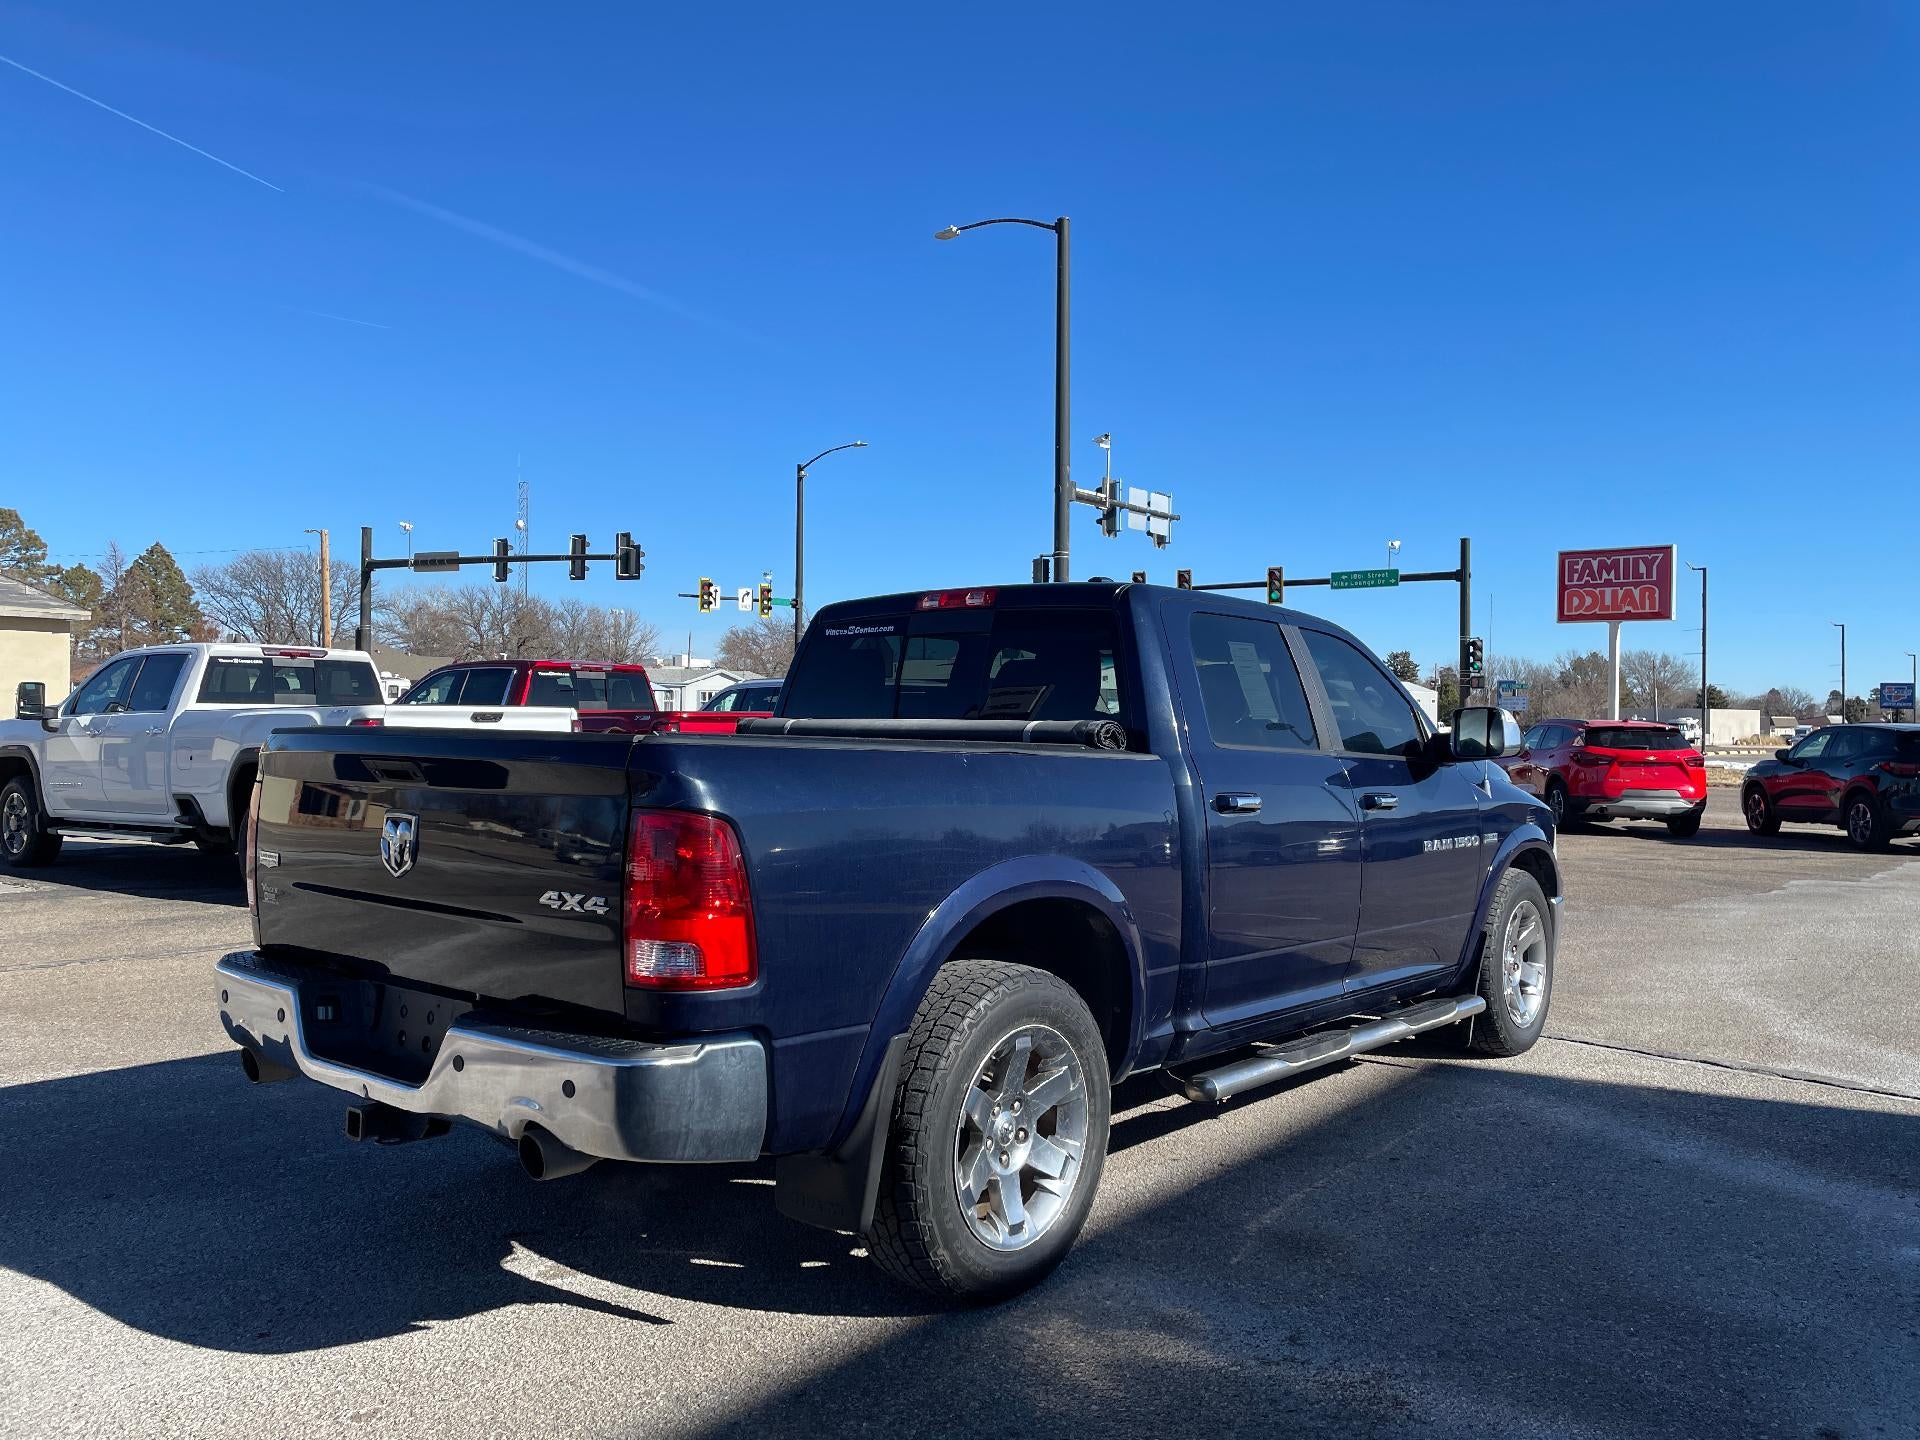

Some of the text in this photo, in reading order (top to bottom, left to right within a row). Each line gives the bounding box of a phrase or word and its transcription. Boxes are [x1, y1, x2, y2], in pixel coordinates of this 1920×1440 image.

[1367, 571, 1389, 579] Street
[1565, 553, 1664, 585] FAMILY
[1564, 584, 1659, 616] DOLLAR
[1423, 838, 1453, 852] RAM
[1454, 834, 1480, 849] 1500
